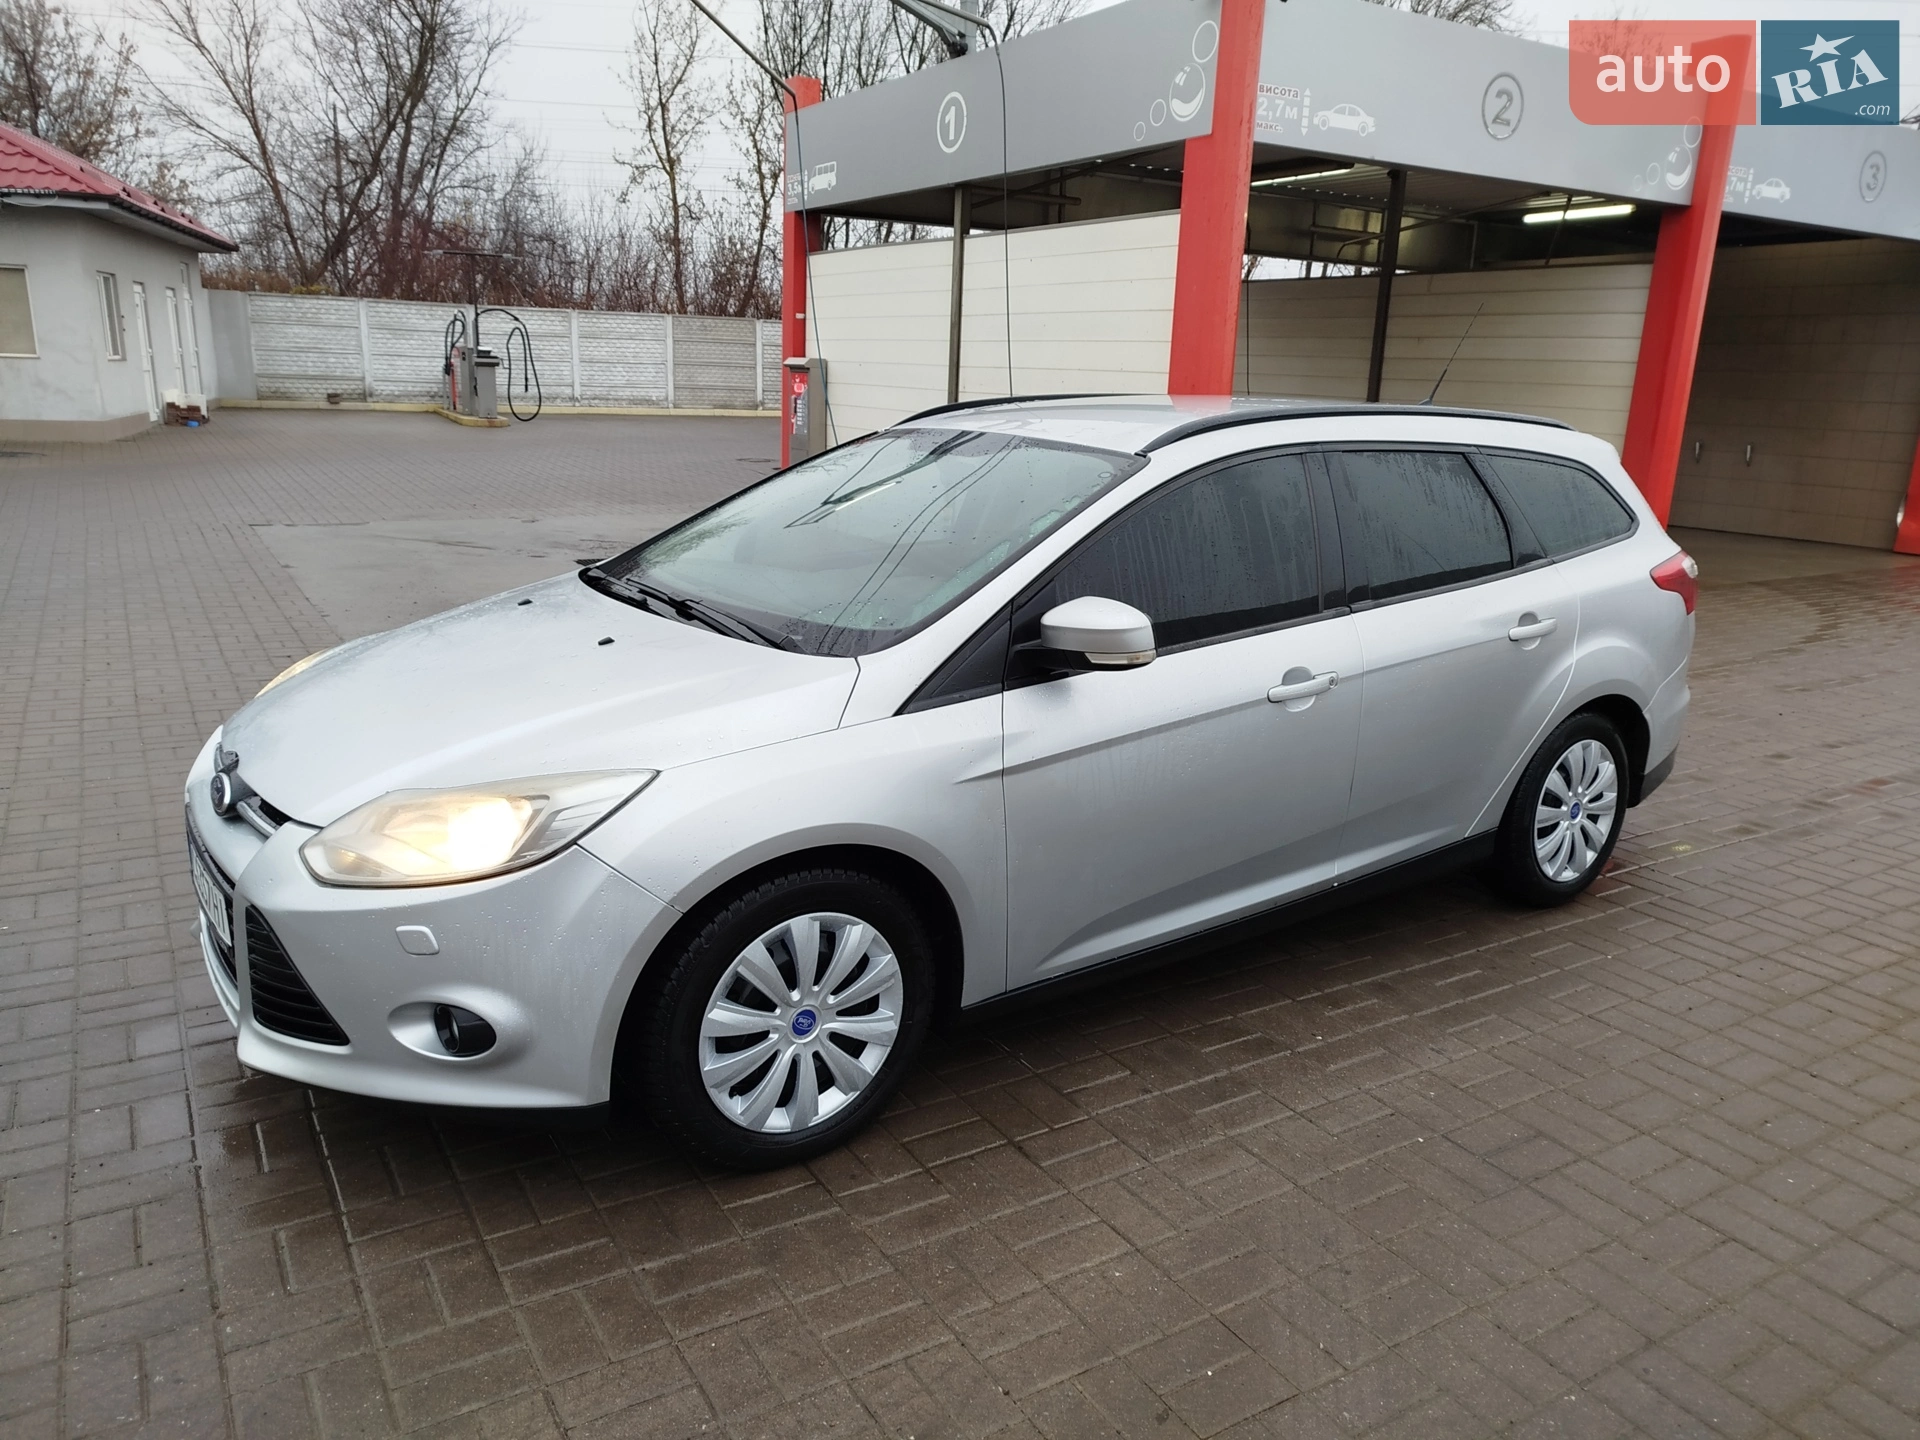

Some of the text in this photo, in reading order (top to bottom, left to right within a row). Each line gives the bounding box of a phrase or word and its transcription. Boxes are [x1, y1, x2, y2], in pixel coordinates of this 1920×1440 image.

[1258, 84, 1299, 99] висота
[1257, 97, 1298, 120] 2,7м
[1491, 88, 1513, 127] 2
[945, 105, 956, 141] 1
[1256, 121, 1283, 132] макс.
[1728, 166, 1748, 177] сота
[1865, 162, 1881, 192] 3
